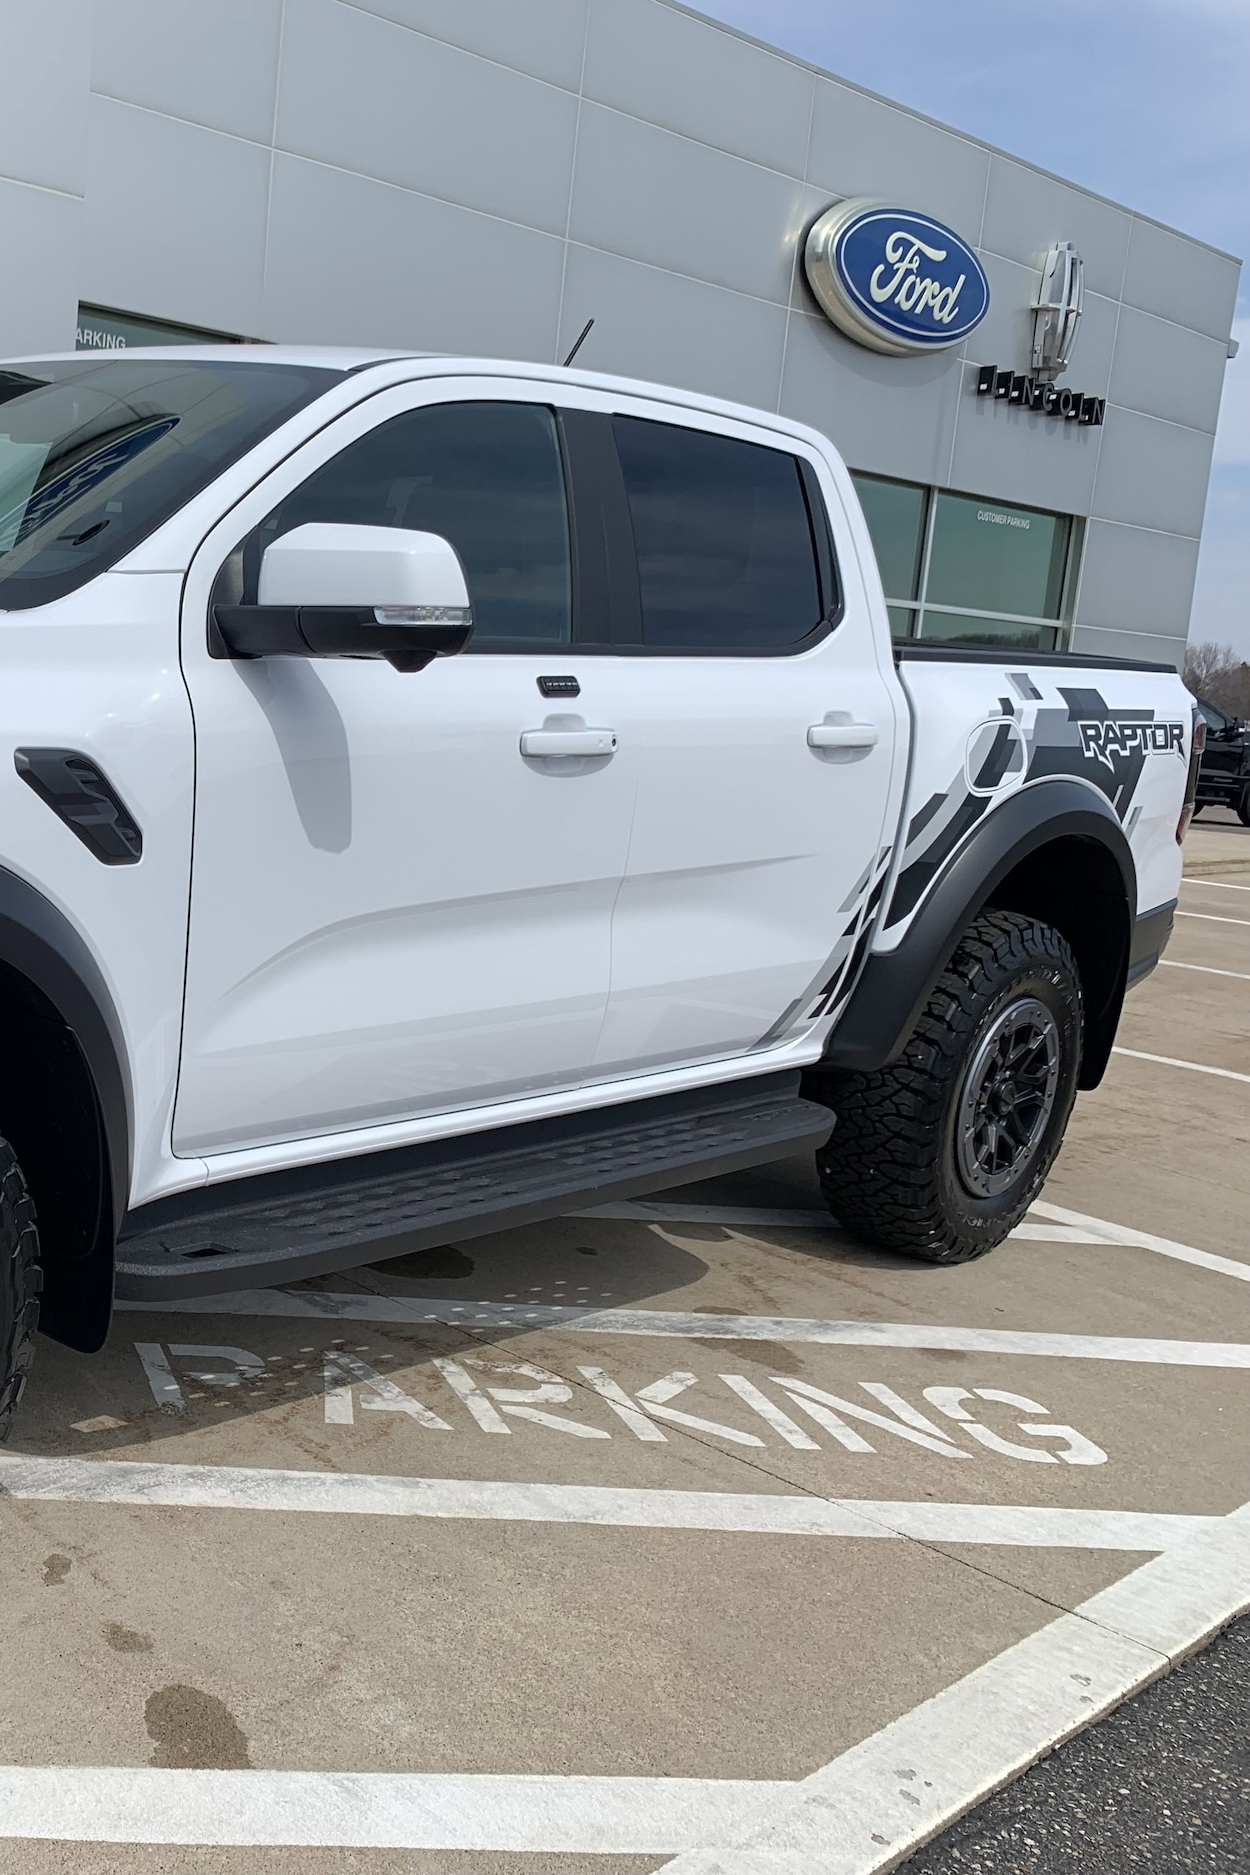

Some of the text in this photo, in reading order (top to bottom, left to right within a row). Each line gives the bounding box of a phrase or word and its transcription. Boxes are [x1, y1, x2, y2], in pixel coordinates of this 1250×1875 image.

[870, 231, 966, 324] Ford
[977, 365, 1106, 426] LINCOLN
[977, 510, 1030, 529] CUSTOMER PARKING
[1078, 720, 1187, 773] RAPTOR
[133, 1341, 1108, 1466] PARKING
